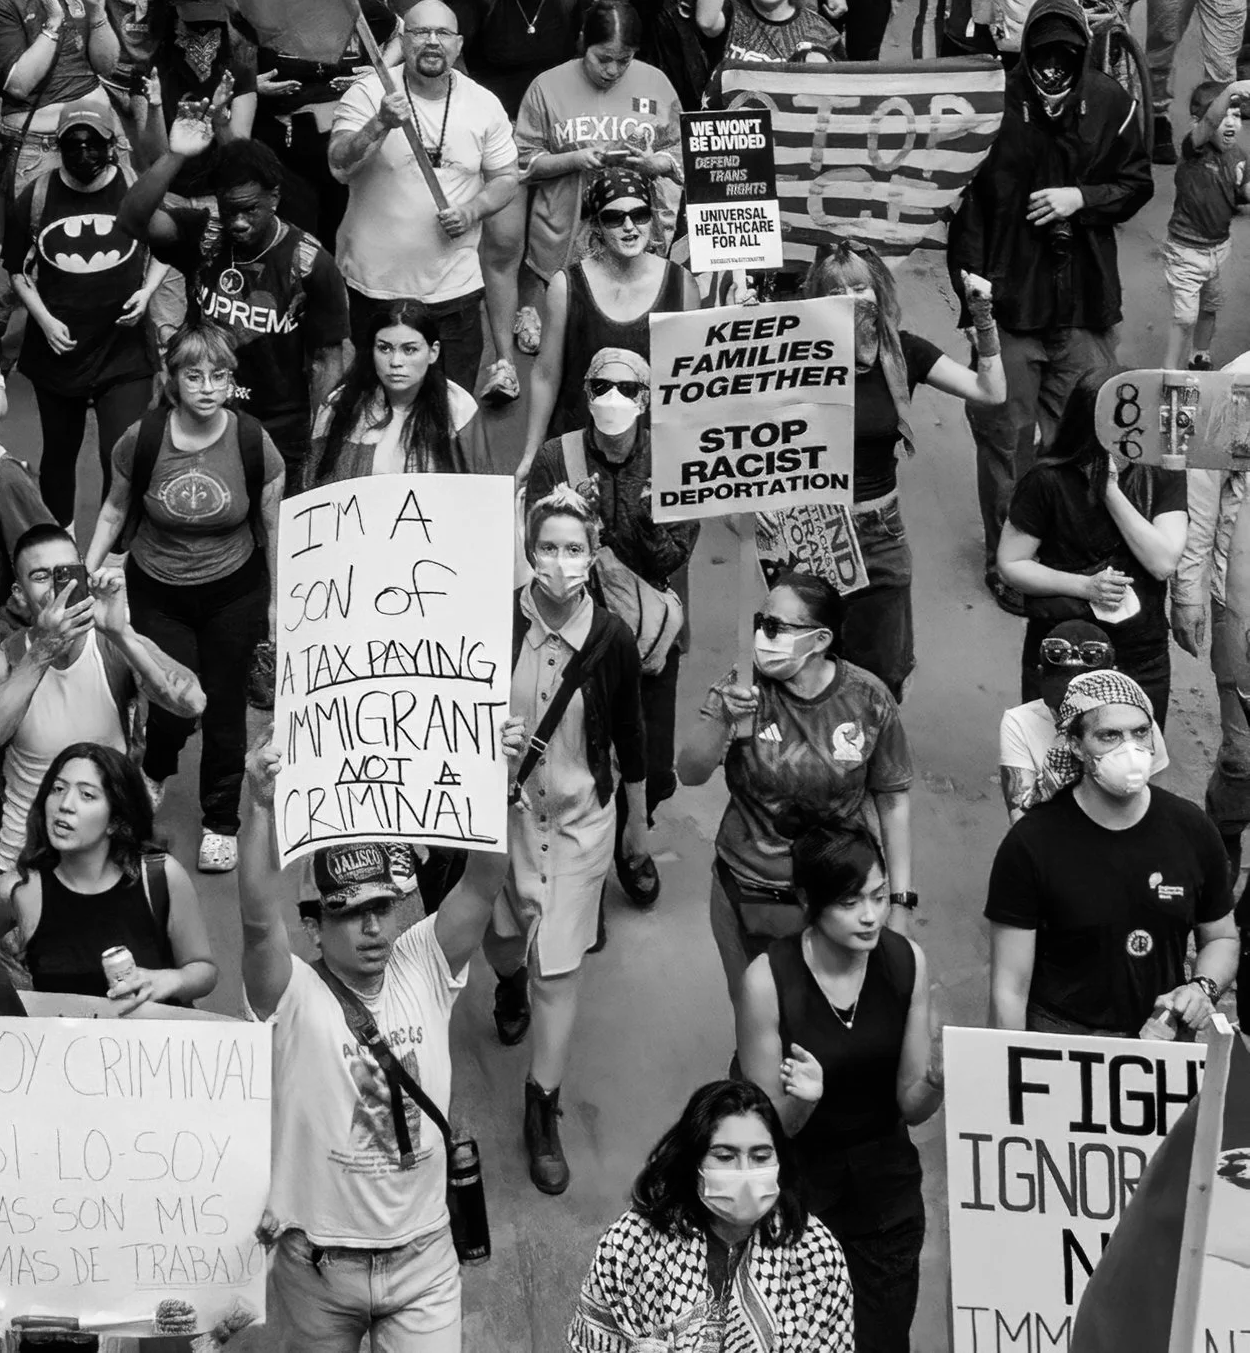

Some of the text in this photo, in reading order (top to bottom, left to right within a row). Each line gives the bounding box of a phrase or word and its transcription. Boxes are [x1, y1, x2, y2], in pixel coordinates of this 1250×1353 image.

[689, 133, 766, 152] BE DIVIDED
[690, 118, 762, 137] WE WON'T
[695, 155, 740, 170] DEFEND
[710, 169, 748, 183] TRANS
[695, 220, 775, 237] HEALTHCARE
[699, 206, 768, 223] UNIVERSAL
[712, 234, 761, 248] FOR ALL
[704, 315, 801, 347] KEEP
[670, 340, 836, 378] FAMILIES
[658, 365, 850, 406] TOGETHER
[699, 419, 809, 454] STOP
[680, 445, 828, 486] RACIST
[659, 473, 850, 508] DEPORTATION
[291, 489, 433, 559] I'M A
[284, 564, 354, 632] SON
[281, 635, 498, 696] A TAX PAYING
[287, 689, 507, 765] IMMIGRANT
[336, 754, 461, 785] NOT A
[283, 784, 498, 845] CRIMINAL
[333, 847, 381, 875] JALISCO
[52, 1192, 126, 1233] SON
[155, 1193, 229, 1236] MIS
[70, 1246, 111, 1286] DE
[119, 1241, 264, 1286] TRABAJO
